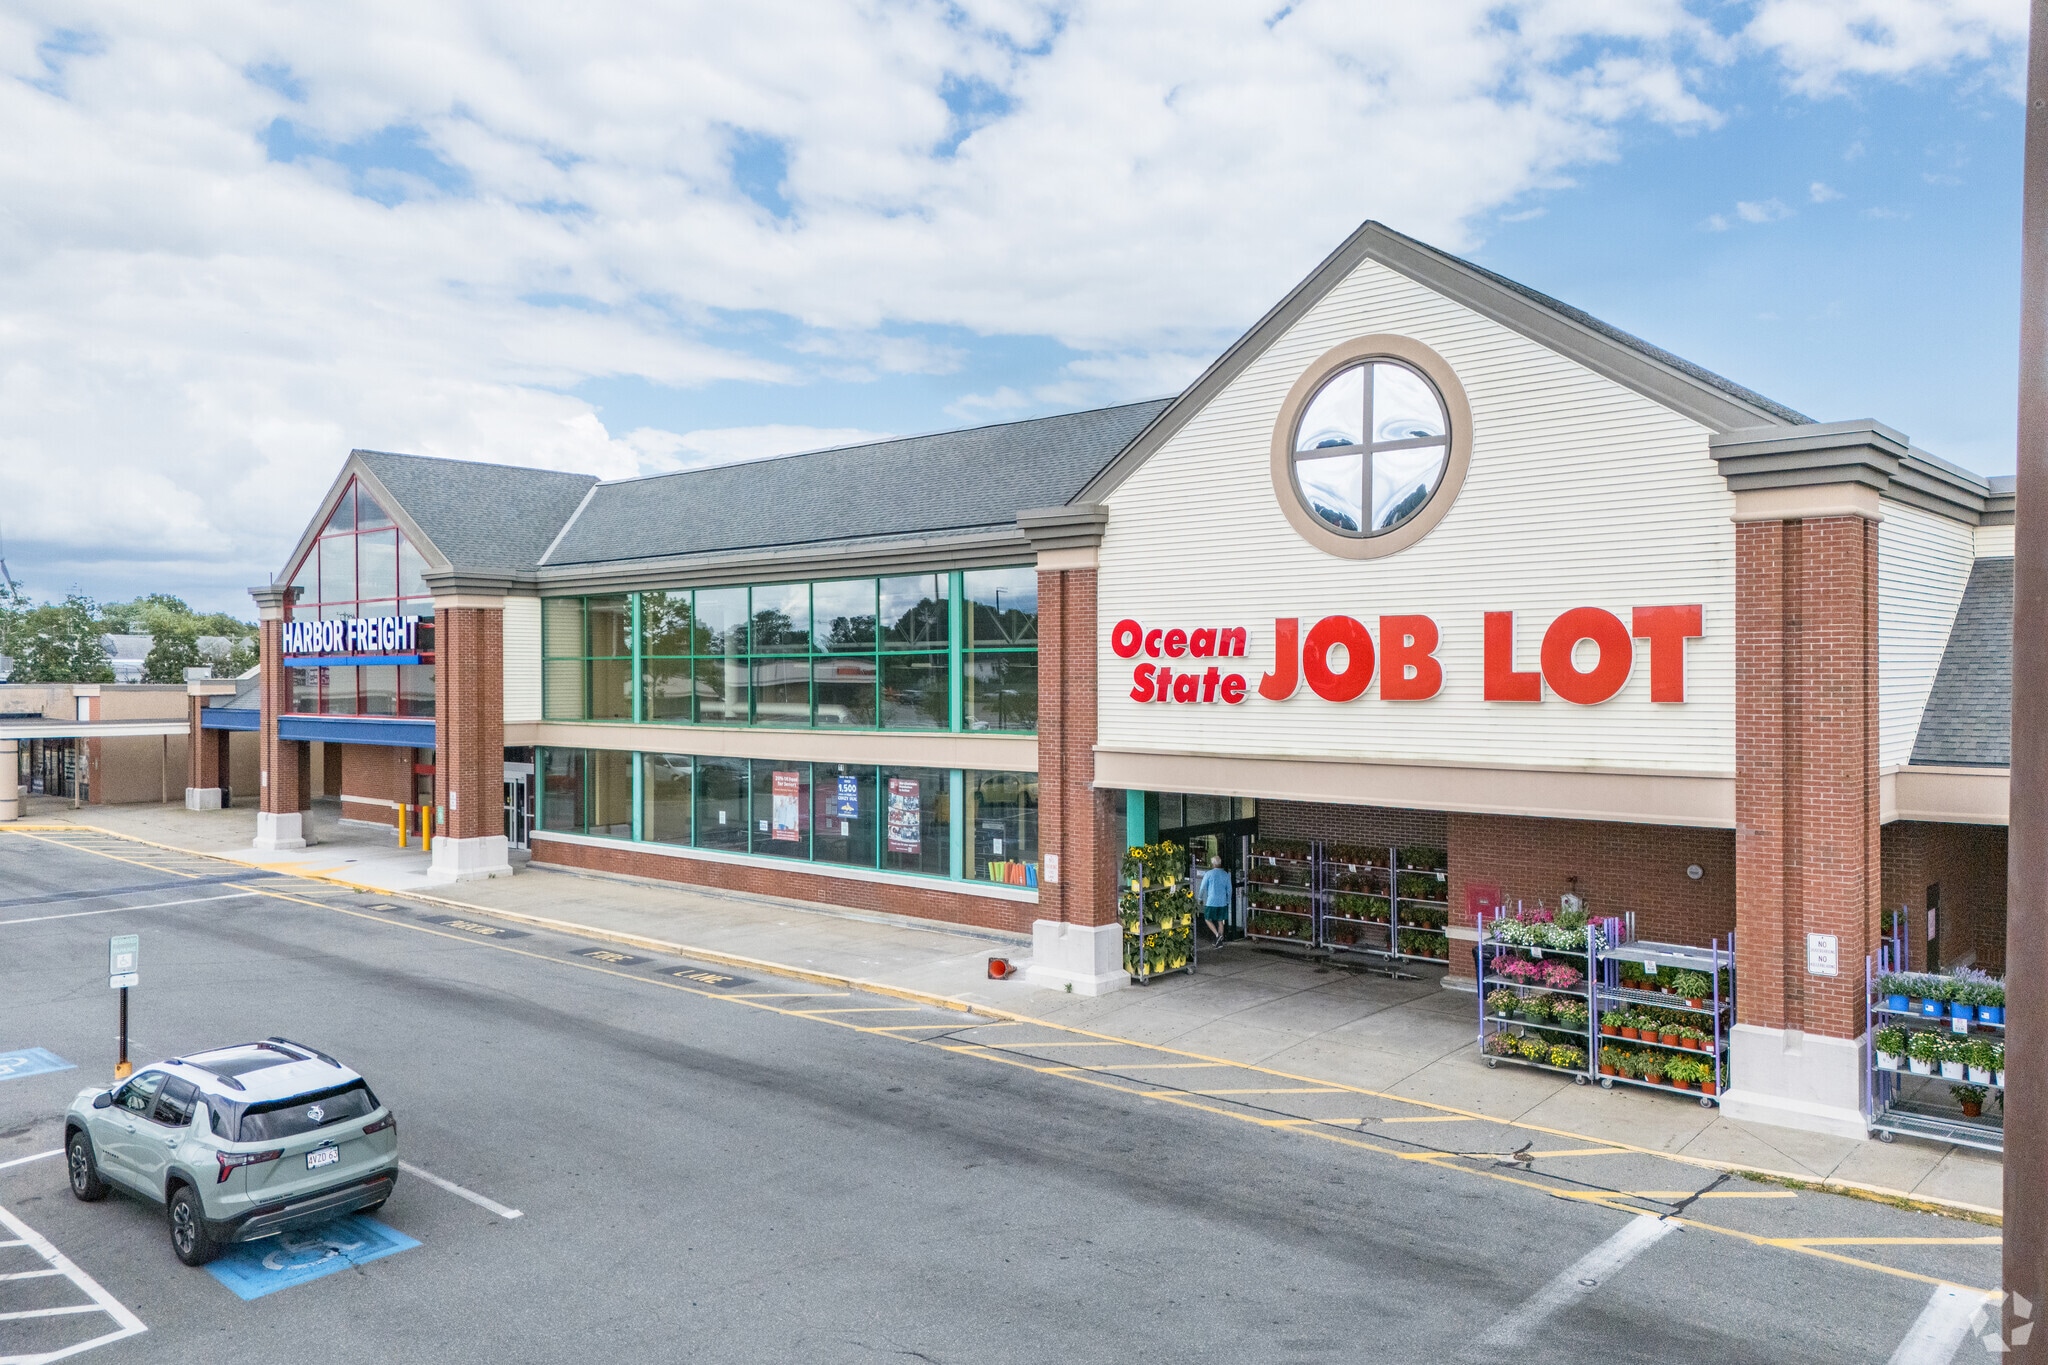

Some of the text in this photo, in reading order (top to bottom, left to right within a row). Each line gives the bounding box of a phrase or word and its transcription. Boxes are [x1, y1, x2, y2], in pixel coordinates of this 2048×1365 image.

[283, 615, 419, 653] HARBOR FREIGHT
[1111, 618, 1248, 659] Ocean
[1257, 603, 1703, 706] JOB LOT
[1129, 662, 1249, 705] State
[582, 950, 635, 963] FIRE
[672, 969, 734, 985] LANE
